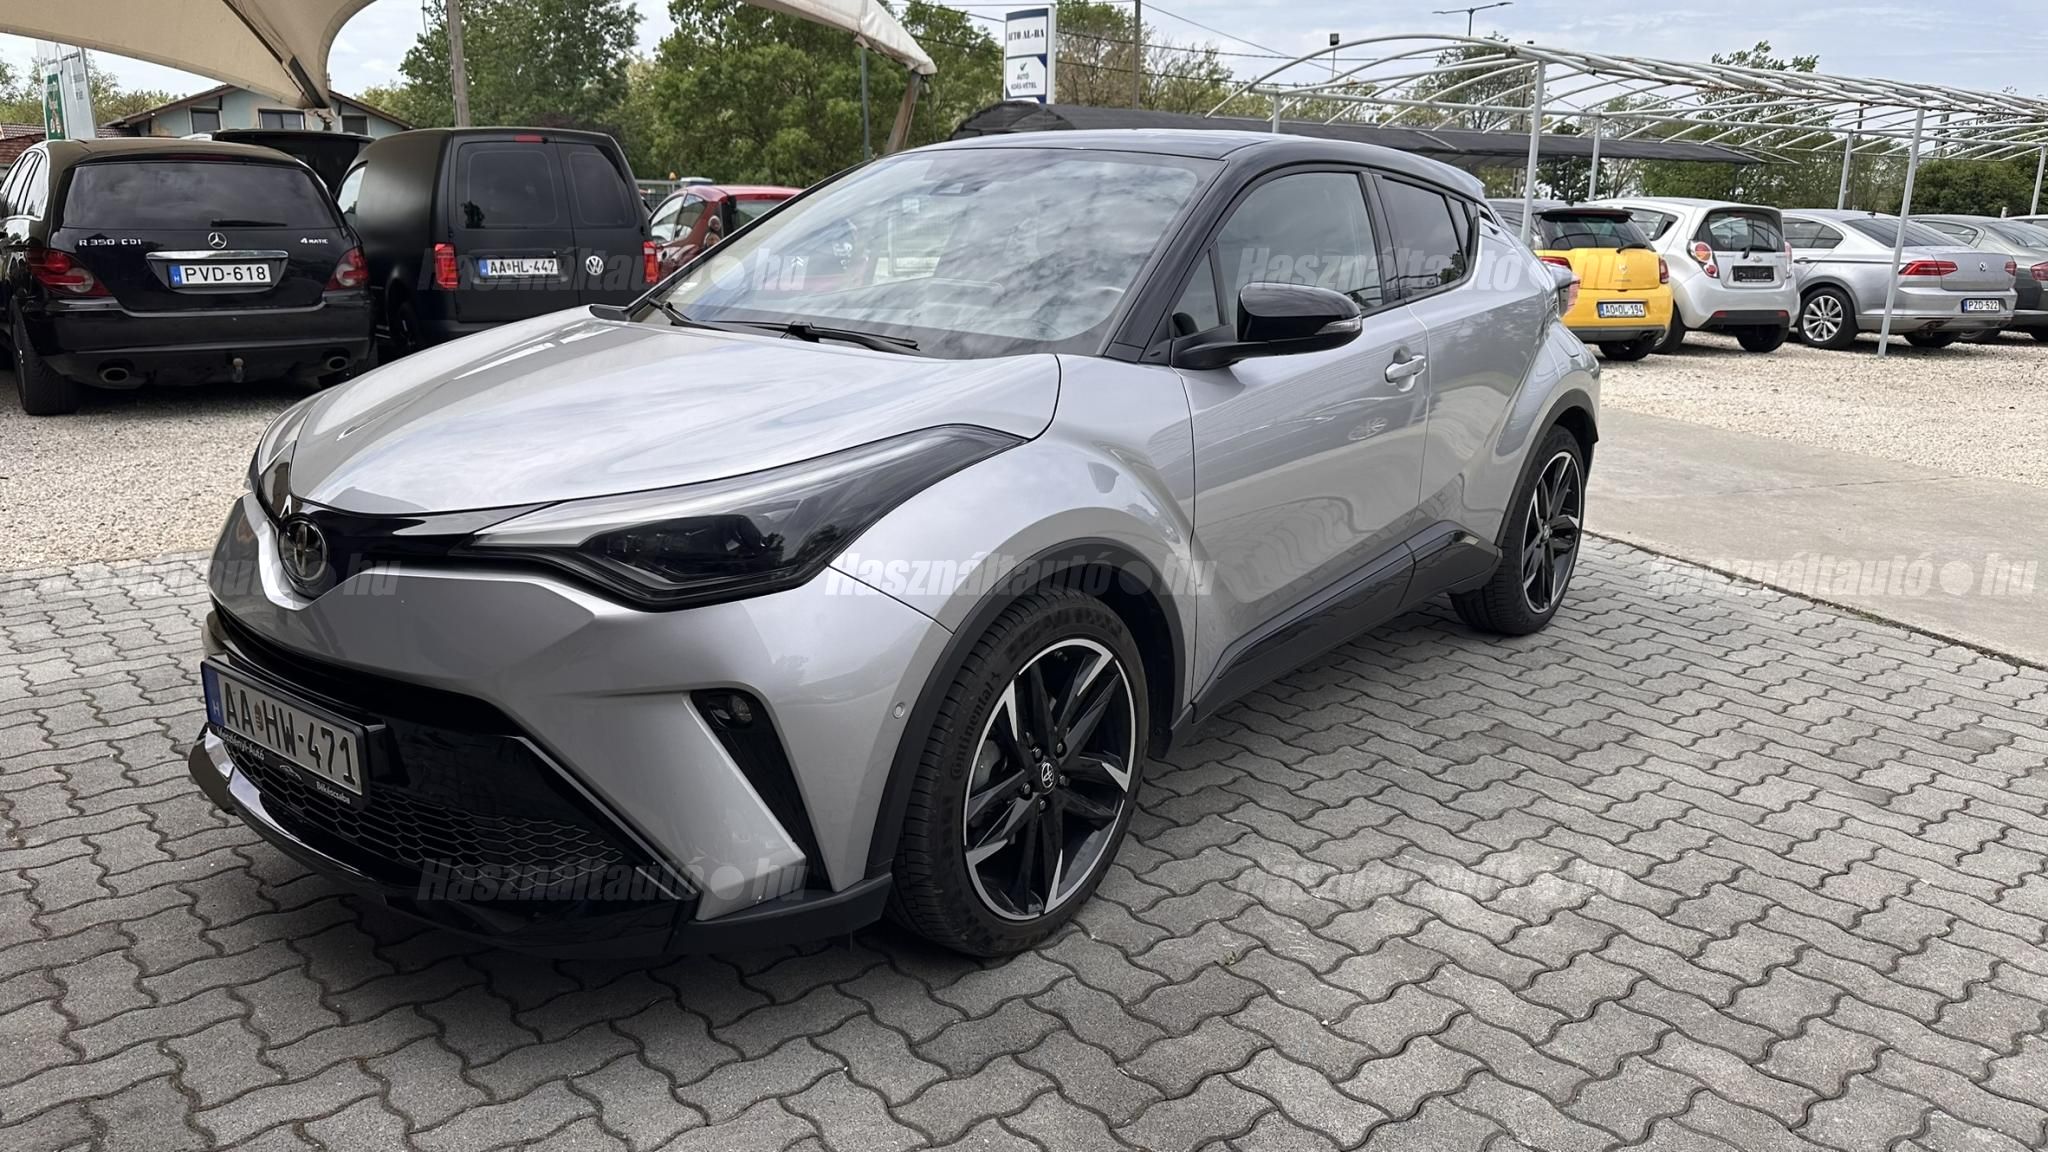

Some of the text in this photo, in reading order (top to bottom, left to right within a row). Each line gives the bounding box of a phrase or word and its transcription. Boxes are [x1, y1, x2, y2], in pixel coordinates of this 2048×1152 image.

[79, 238, 142, 247] R 350 CDI
[184, 265, 267, 282] PVD-618
[1968, 300, 1999, 310] PZD-522
[950, 682, 994, 779] Continental
